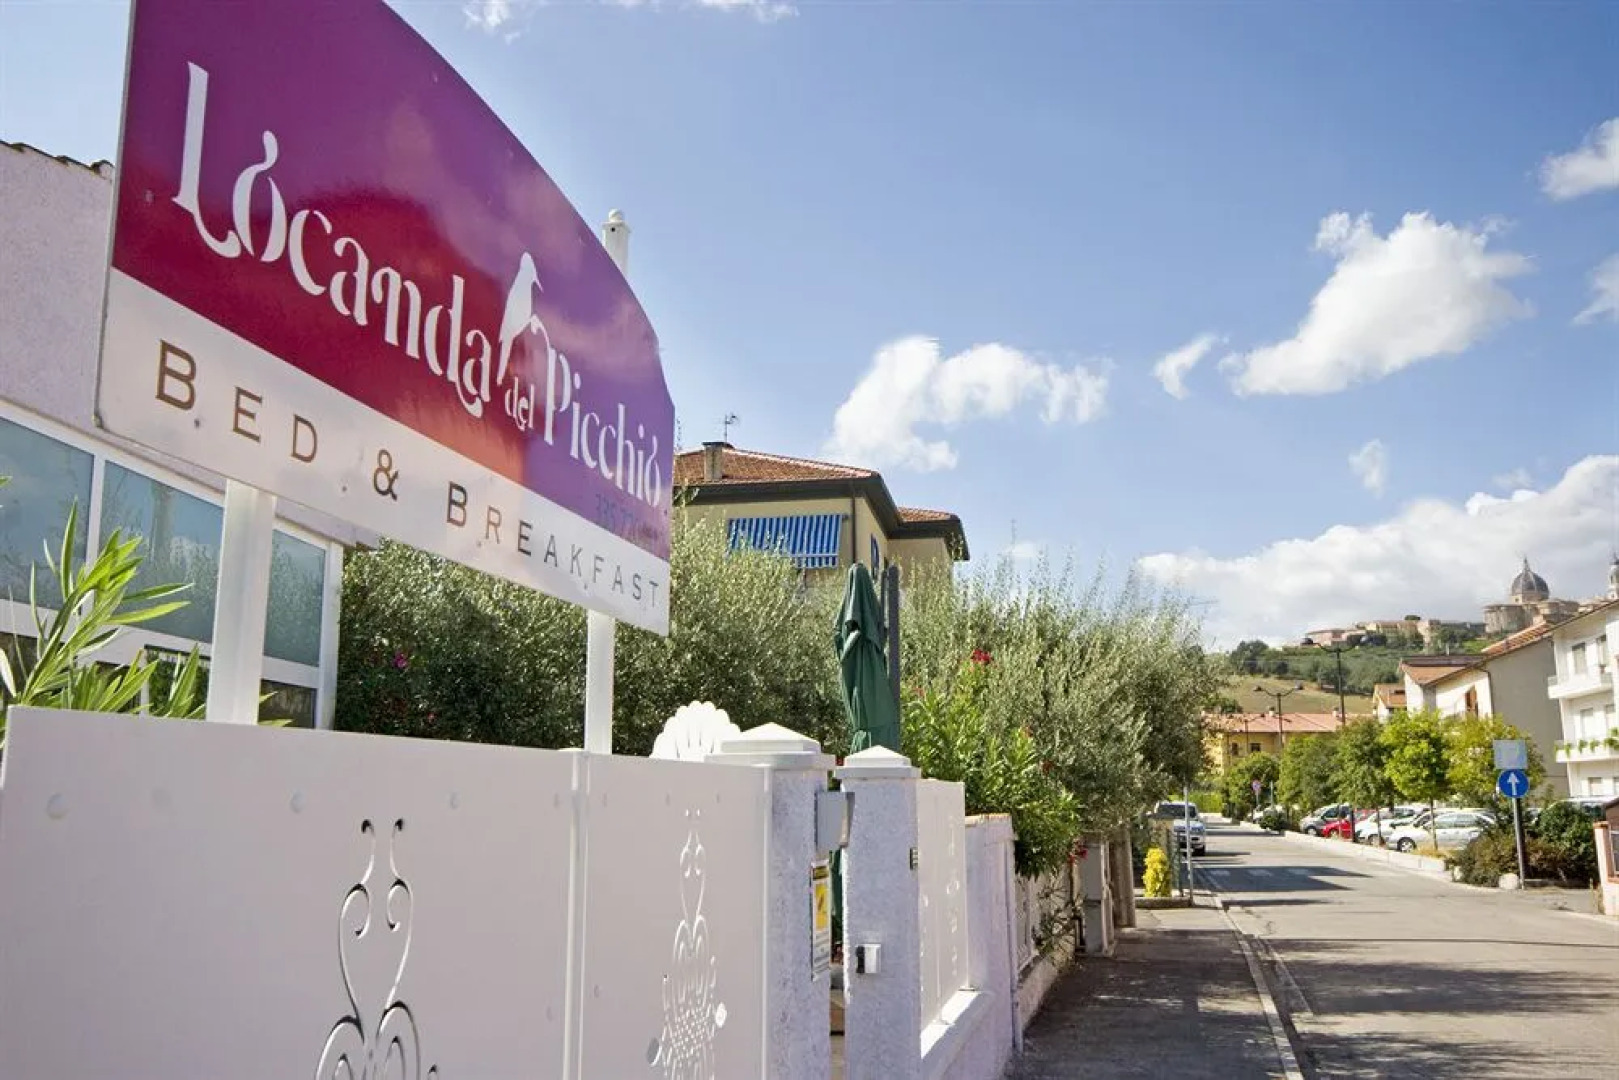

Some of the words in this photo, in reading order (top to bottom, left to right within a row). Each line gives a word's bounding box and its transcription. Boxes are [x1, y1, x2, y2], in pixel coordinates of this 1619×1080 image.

[171, 61, 492, 418] Locanda
[505, 377, 535, 431] del
[531, 314, 661, 507] Picchio
[155, 339, 318, 463] BED
[373, 449, 399, 501] &
[446, 480, 660, 608] BREAKFAST
